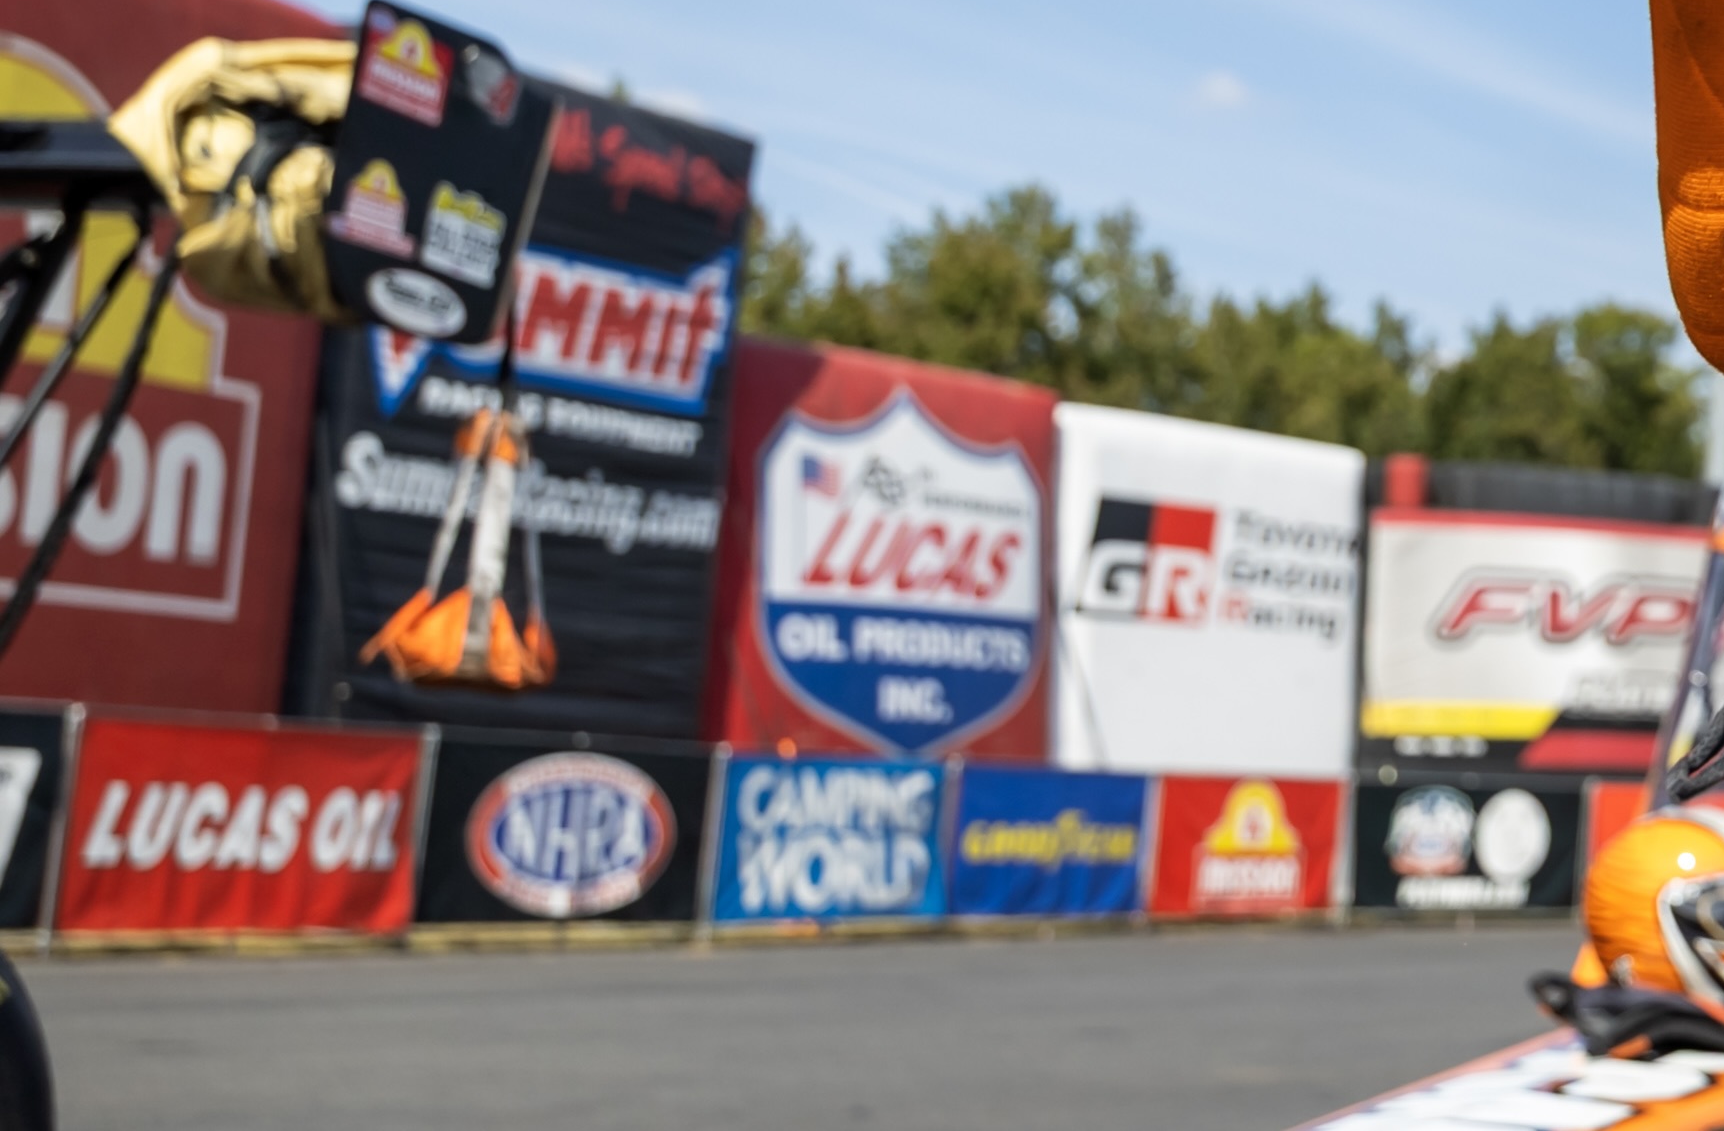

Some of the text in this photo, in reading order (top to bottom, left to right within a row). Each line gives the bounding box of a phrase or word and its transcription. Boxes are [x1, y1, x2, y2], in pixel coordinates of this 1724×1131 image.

[804, 511, 1023, 601] LUCAS
[776, 615, 1031, 673] OIL PRODUCTS
[1436, 580, 1694, 644] FVP
[877, 677, 952, 723] INC.
[82, 778, 310, 873] LUCAS
[309, 786, 400, 872] OIL
[504, 785, 644, 881] NHRA
[737, 763, 937, 834] CAMPING
